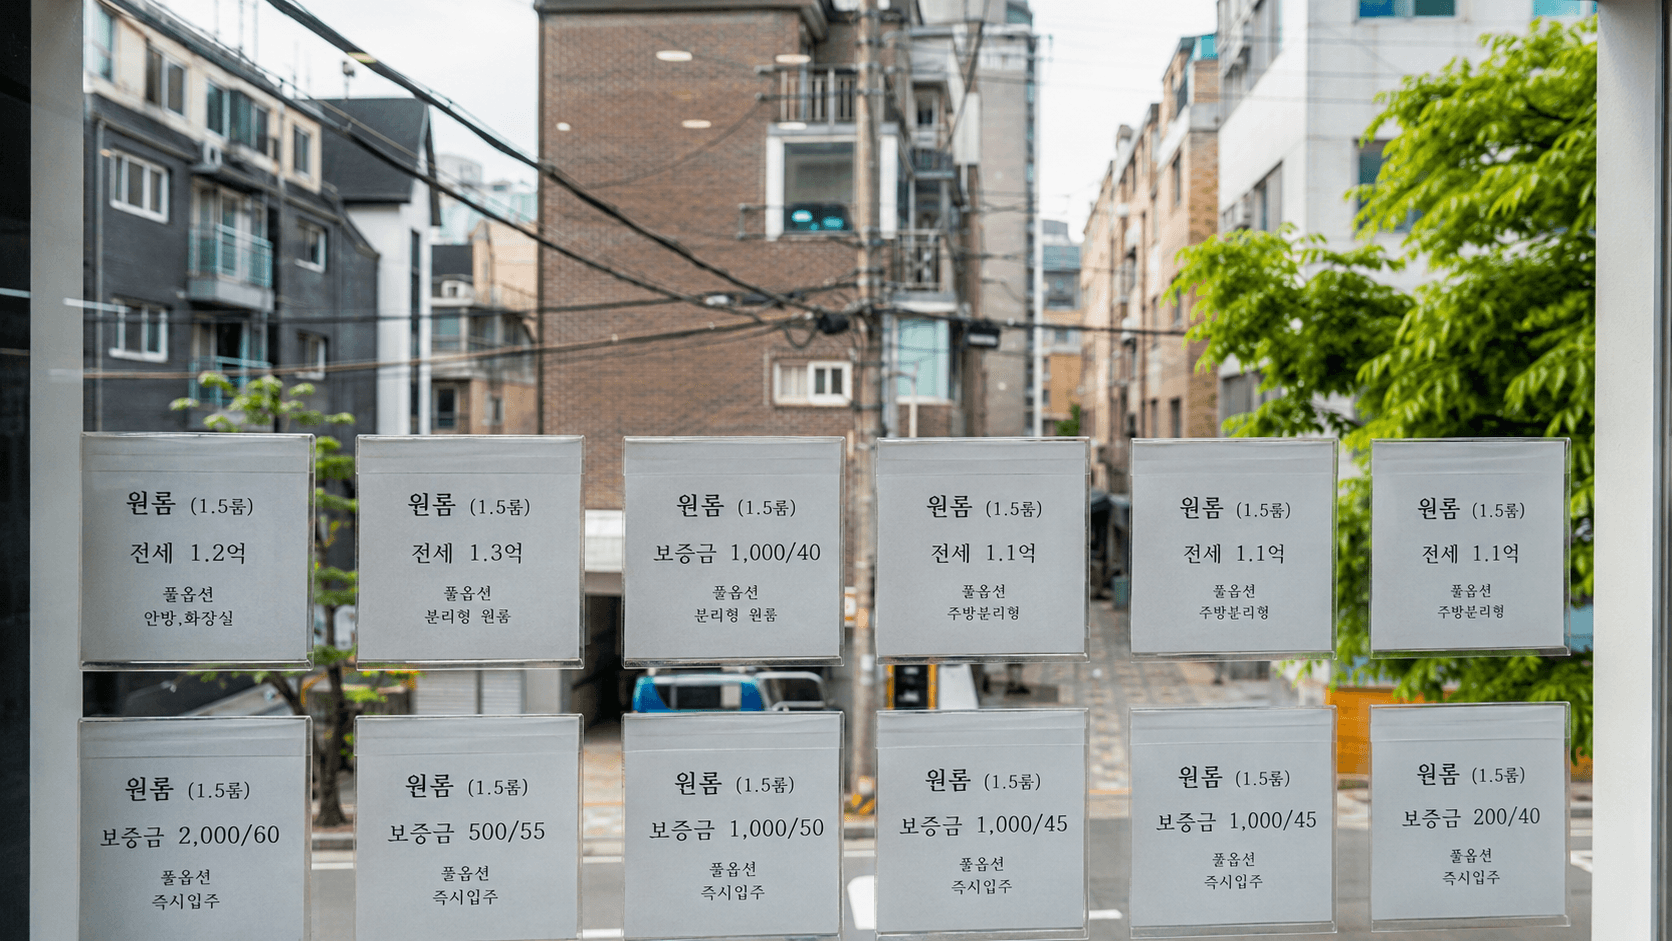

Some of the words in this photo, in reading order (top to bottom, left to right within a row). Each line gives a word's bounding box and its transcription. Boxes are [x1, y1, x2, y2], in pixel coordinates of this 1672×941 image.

[129, 541, 173, 565] 전세
[191, 542, 245, 565] 1.2억
[411, 541, 453, 565] 전세
[470, 541, 522, 565] 1.3억
[653, 543, 718, 565] 보증금
[731, 541, 821, 564] 1,000/40
[931, 542, 970, 564] 전세
[987, 542, 1035, 564] 1.1억
[1183, 542, 1221, 565] 전세
[1237, 543, 1284, 565] 1.1억
[1422, 543, 1458, 565] 전세
[1473, 542, 1519, 564] 1.1억
[162, 585, 214, 604] 풀옵션
[443, 585, 491, 602] 풀옵션
[712, 584, 758, 601] 풀옵션
[961, 583, 1006, 600] 풀옵션
[1212, 583, 1255, 599] 풀옵션
[1450, 583, 1491, 599] 풀옵션
[143, 609, 233, 628] 안방,화장실
[424, 608, 470, 625] 분리형
[694, 607, 739, 624] 분리형
[947, 605, 1019, 622] 주방분리형
[1199, 605, 1269, 621] 주방분리형
[1437, 604, 1504, 620] 주방분리형
[899, 815, 963, 838] 보증금
[977, 813, 1068, 836] 1,000/45
[1155, 812, 1217, 834] 보증금
[1230, 809, 1317, 832] 1,000/45
[1401, 808, 1462, 830] 보증금
[1473, 805, 1541, 828] 200/40
[178, 823, 280, 848] 2,000/60
[387, 822, 455, 846] 보증금
[468, 819, 545, 844] 500/55
[648, 819, 716, 842] 보증금
[730, 816, 824, 841] 1,000/50
[1449, 847, 1492, 864] 풀옵션
[440, 865, 489, 882] 풀옵션
[708, 860, 756, 878] 풀옵션
[1442, 869, 1501, 887] 즉시입주
[951, 878, 1013, 896] 즉시입주
[1204, 873, 1263, 890] 즉시입주
[151, 892, 221, 911] 즉시입주
[432, 888, 499, 907] 즉시입주
[700, 884, 765, 901] 즉시입주
